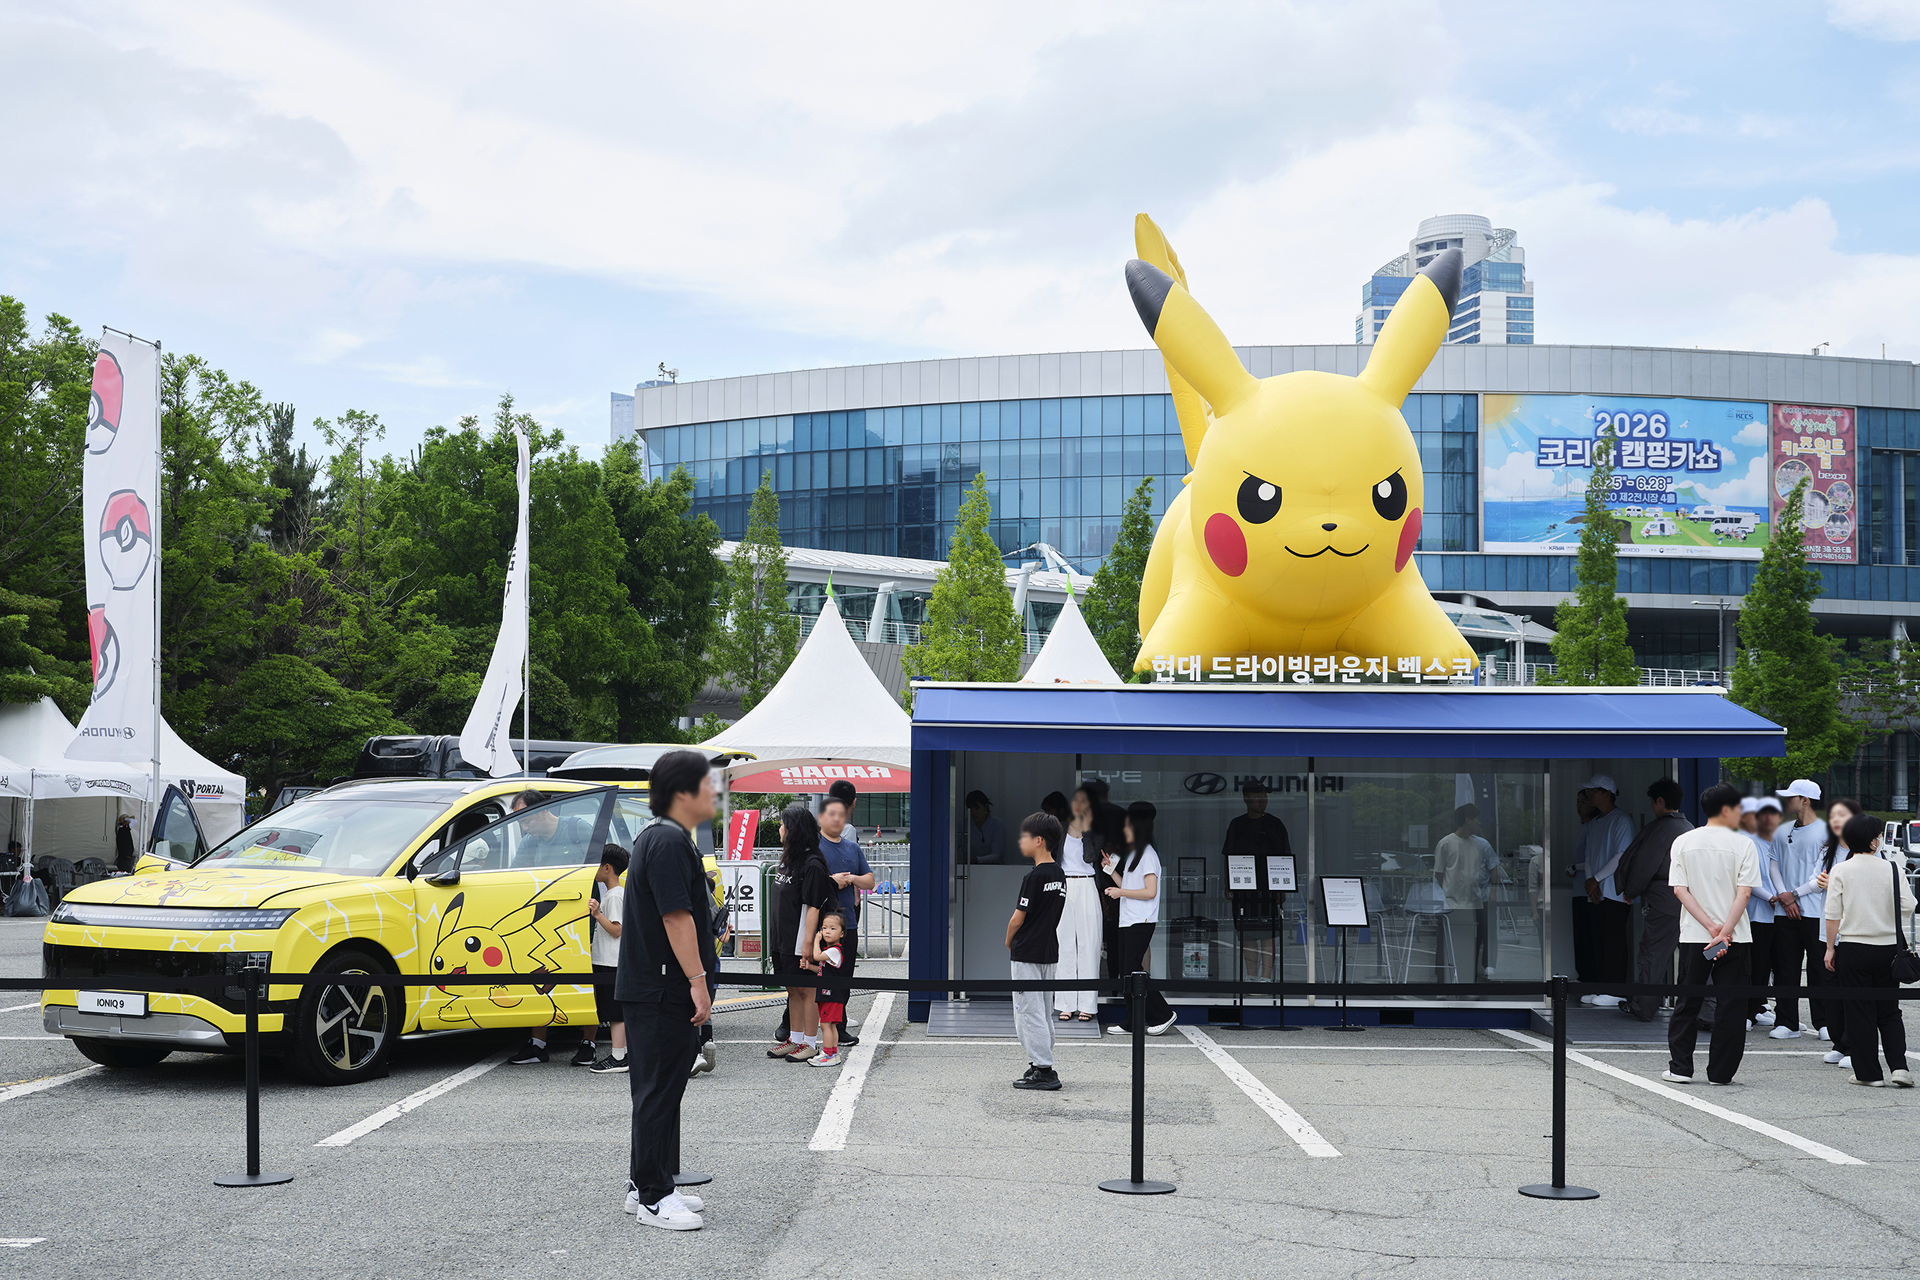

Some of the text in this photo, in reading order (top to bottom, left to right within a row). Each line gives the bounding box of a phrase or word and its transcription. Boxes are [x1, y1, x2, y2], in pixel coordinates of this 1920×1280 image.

[1596, 412, 1667, 439] 2026
[1790, 417, 1837, 436] 상상체험
[1539, 439, 1719, 470] 코리아 캠핑카쇼
[1781, 436, 1847, 470] 키즈월드
[1817, 471, 1848, 480] bexco
[1619, 492, 1658, 503] 제2전시장
[1660, 493, 1676, 504] 4홀
[1152, 655, 1476, 683] 현대 드라이빙라운지 벡스코
[195, 783, 225, 795] PORTAL
[96, 998, 124, 1009] IONIQ 9
